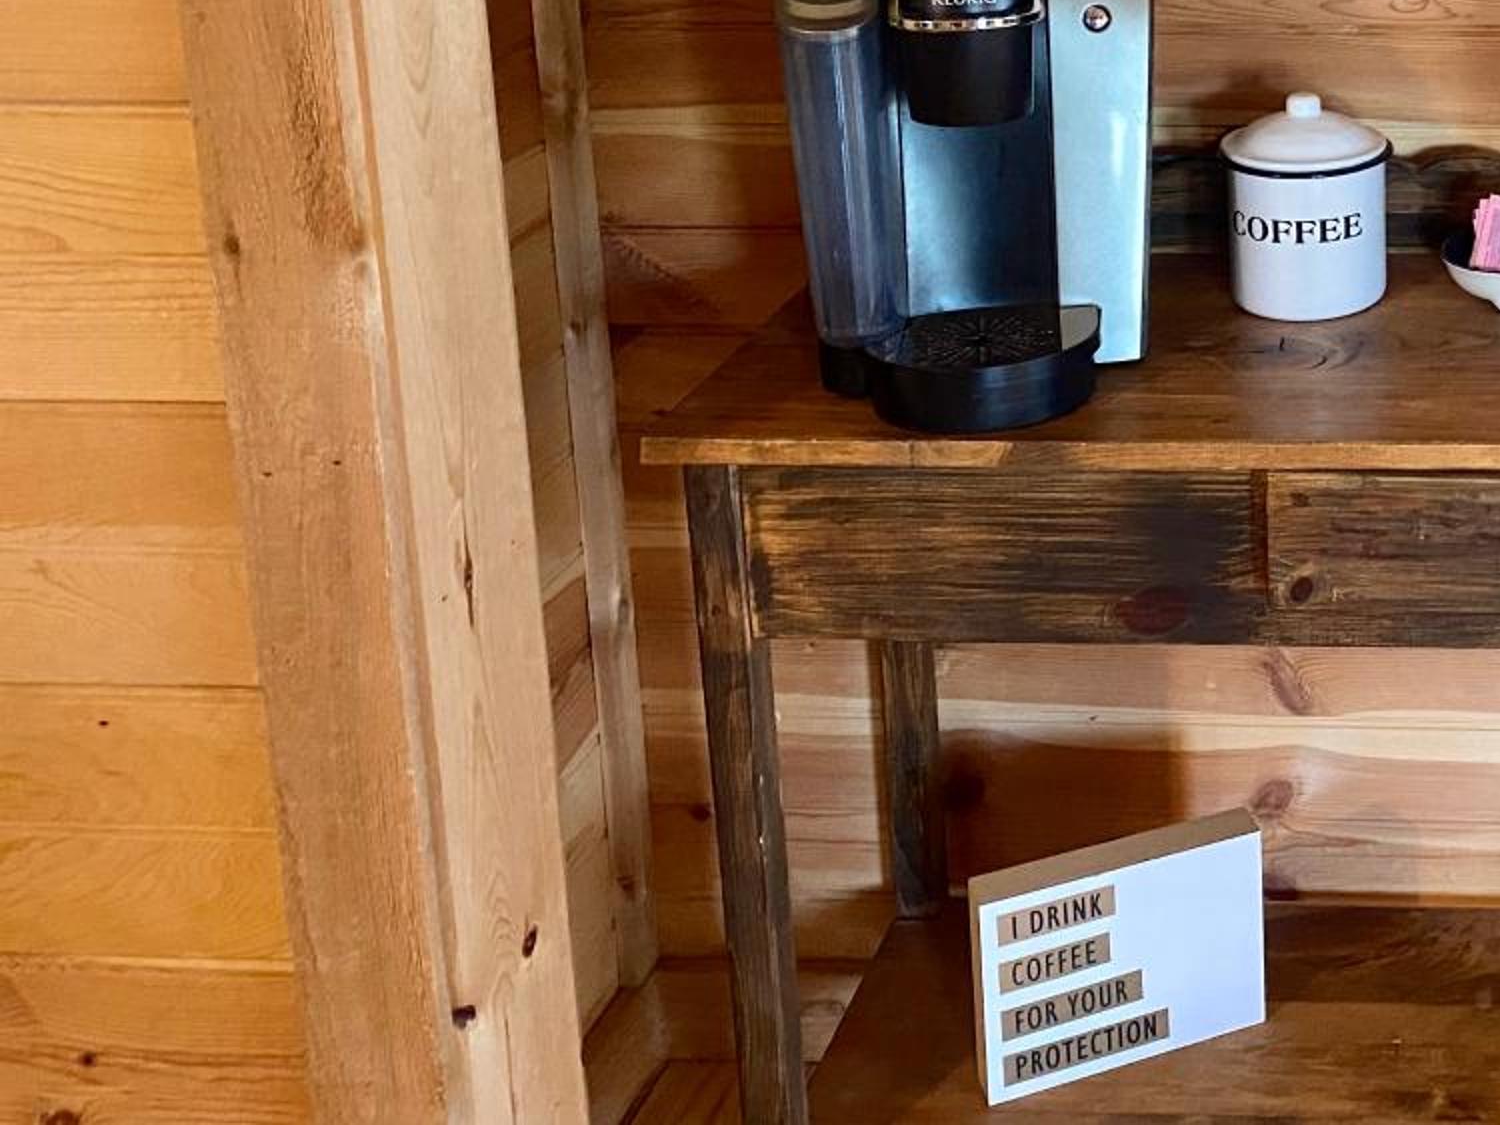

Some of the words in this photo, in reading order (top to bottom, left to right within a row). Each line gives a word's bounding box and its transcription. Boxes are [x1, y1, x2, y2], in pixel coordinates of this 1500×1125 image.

[1232, 212, 1362, 244] COFFEE
[1011, 916, 1018, 939] I
[1030, 893, 1103, 934] DRINK
[1011, 940, 1098, 986] COFFEE
[1014, 1001, 1058, 1034] FOR
[1067, 980, 1127, 1015] YOUR
[1015, 1013, 1158, 1079] PROTECTION
